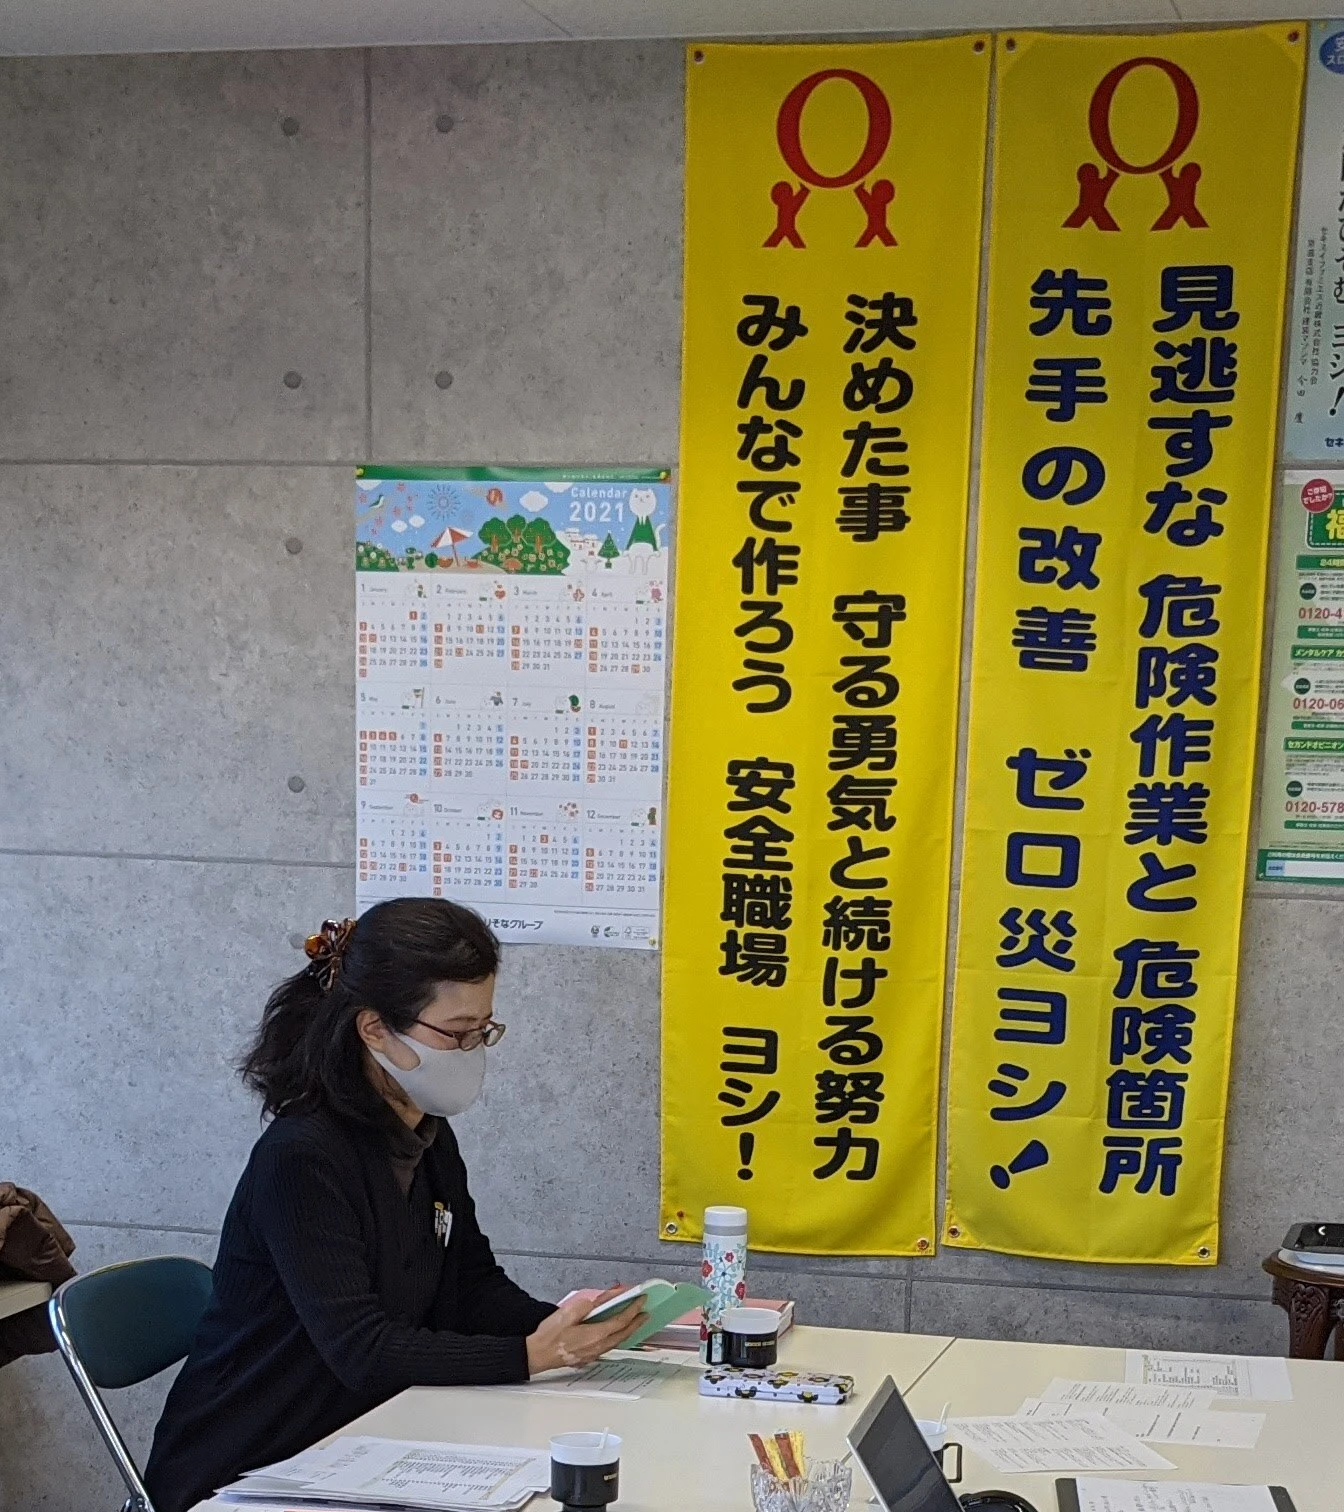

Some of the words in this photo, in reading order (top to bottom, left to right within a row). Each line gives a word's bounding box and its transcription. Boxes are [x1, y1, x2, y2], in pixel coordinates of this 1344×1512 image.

[569, 501, 624, 522] 2021
[571, 487, 628, 498] Calendar
[732, 293, 809, 714] みんなで作ろう
[834, 291, 918, 542] 決めた事
[1012, 268, 1112, 672] 先手の改善
[720, 756, 796, 987] 安全職場
[813, 589, 907, 1181] 守る勇気と続ける努力
[1099, 264, 1240, 1196] 見逃すな危険作業と危険箇所
